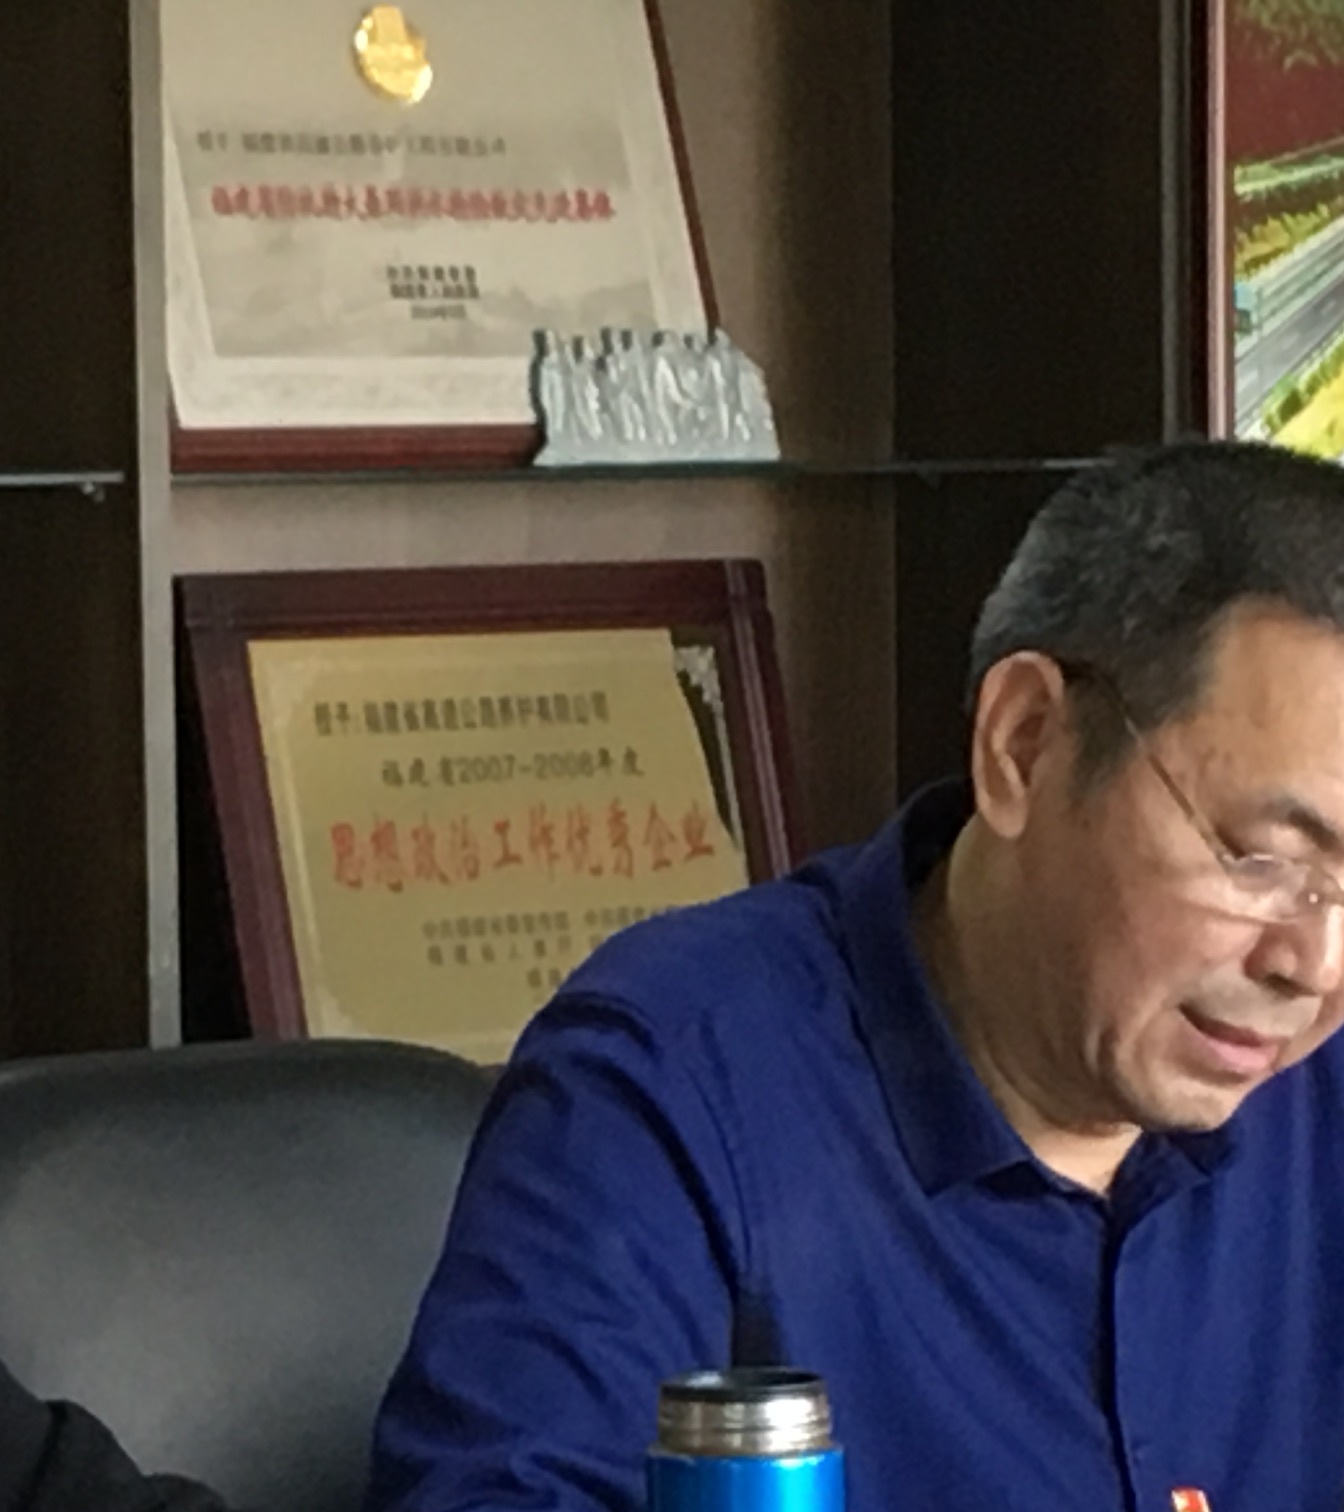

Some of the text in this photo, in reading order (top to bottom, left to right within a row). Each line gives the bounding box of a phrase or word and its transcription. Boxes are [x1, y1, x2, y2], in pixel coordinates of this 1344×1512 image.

[331, 799, 716, 893] 思想政治工作优秀企业
